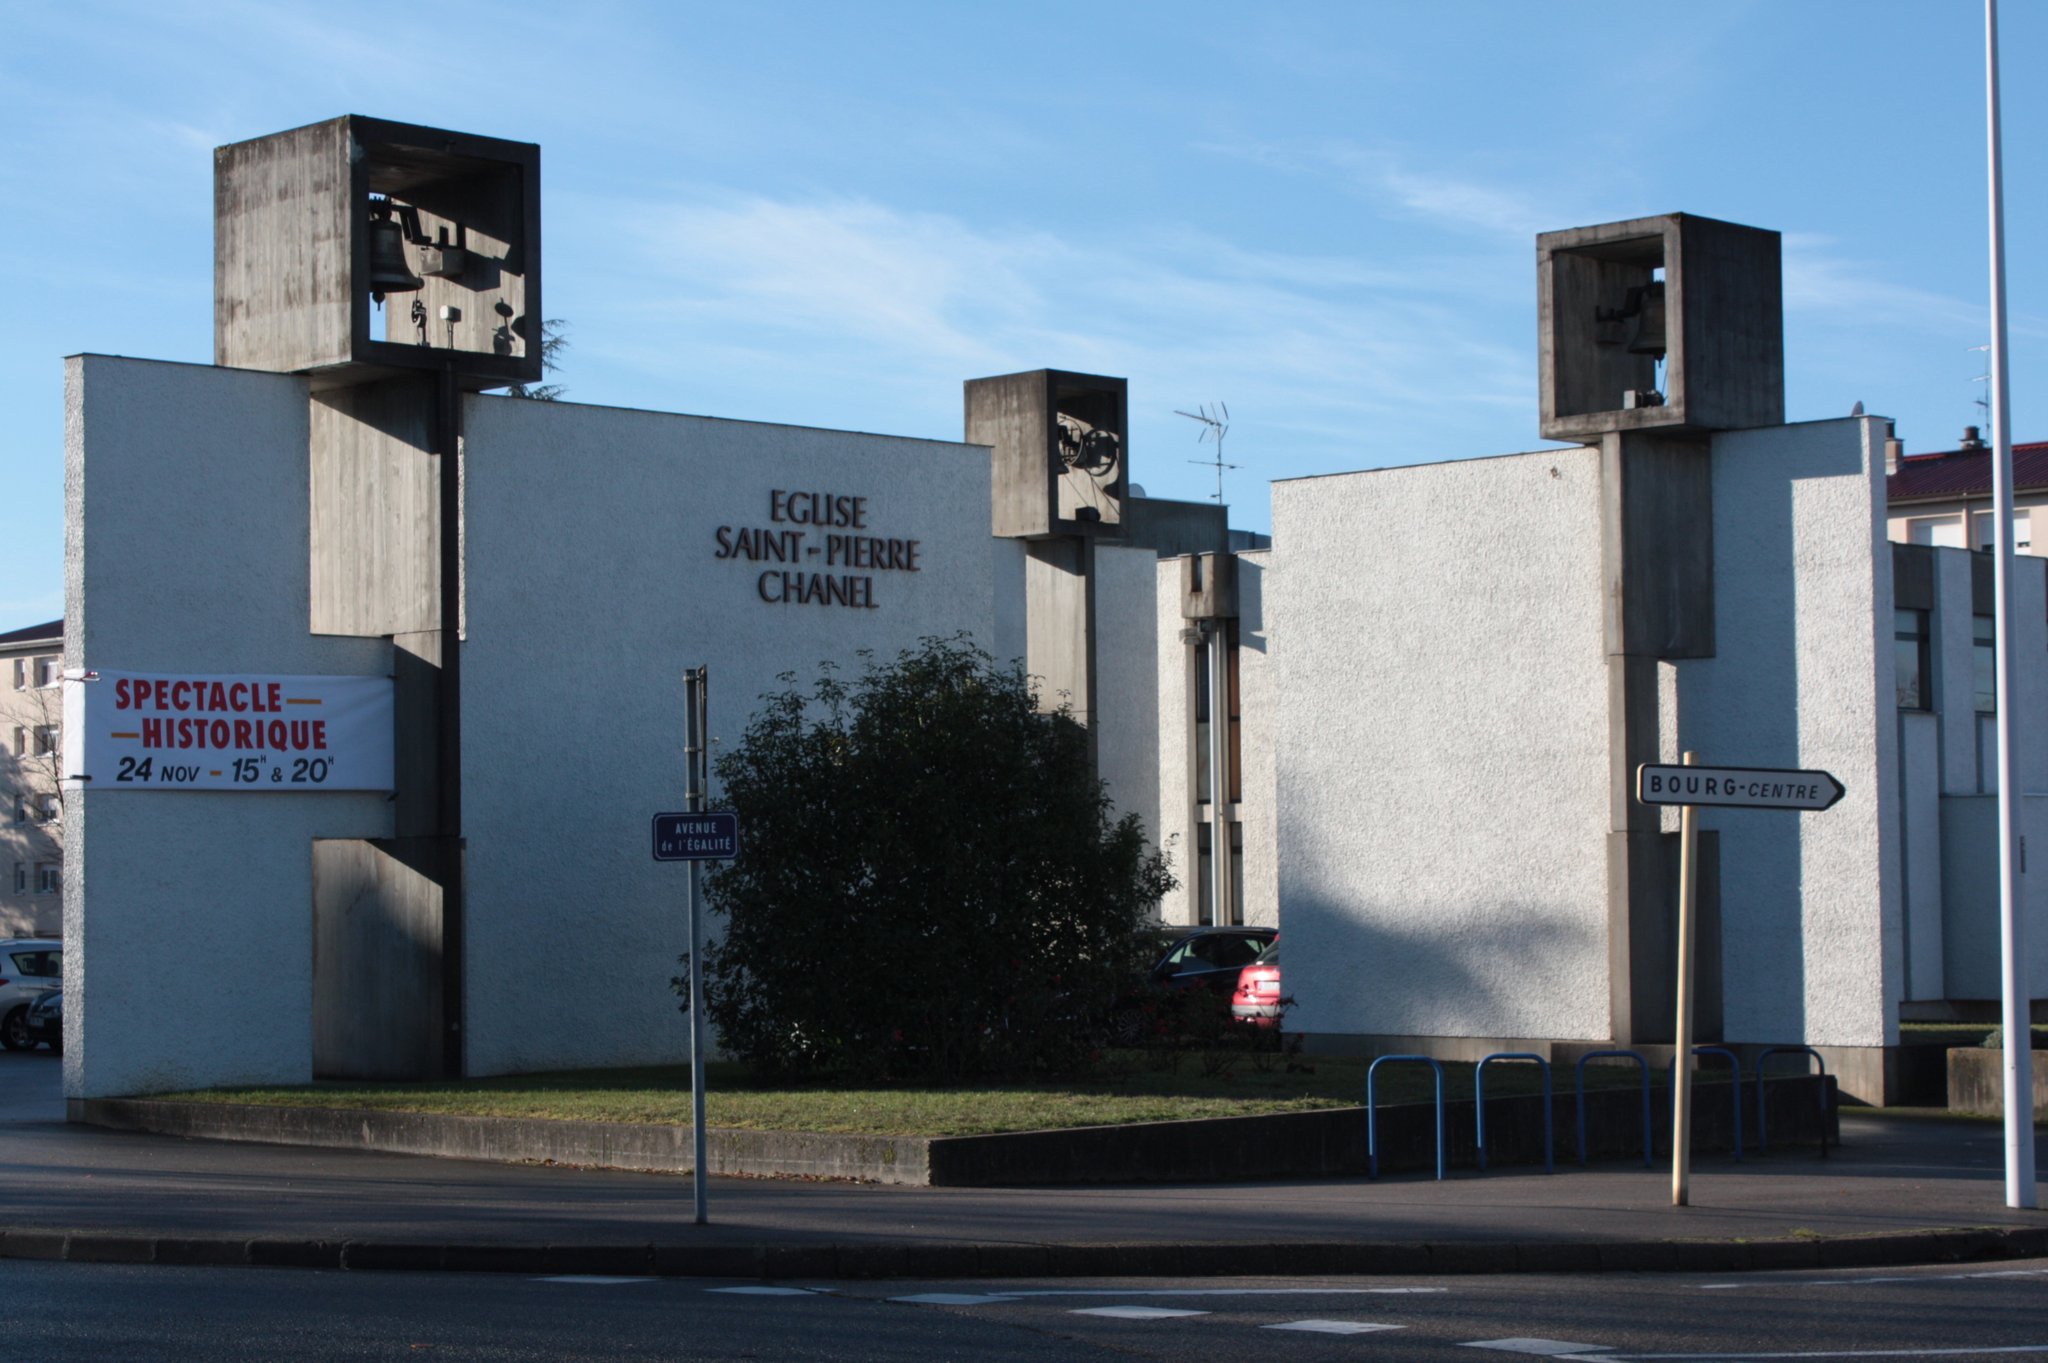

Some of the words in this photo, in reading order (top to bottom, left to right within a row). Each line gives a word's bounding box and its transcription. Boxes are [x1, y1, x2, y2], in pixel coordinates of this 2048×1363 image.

[771, 489, 867, 529] EGLISE
[758, 570, 880, 609] CHANEL
[115, 678, 282, 712] SPECTACLE
[142, 718, 327, 751] HISTORIQUE
[116, 757, 152, 782] 24
[161, 766, 200, 781] NOV
[271, 768, 283, 782] &
[675, 822, 717, 834] AVENUE
[661, 841, 673, 852] de
